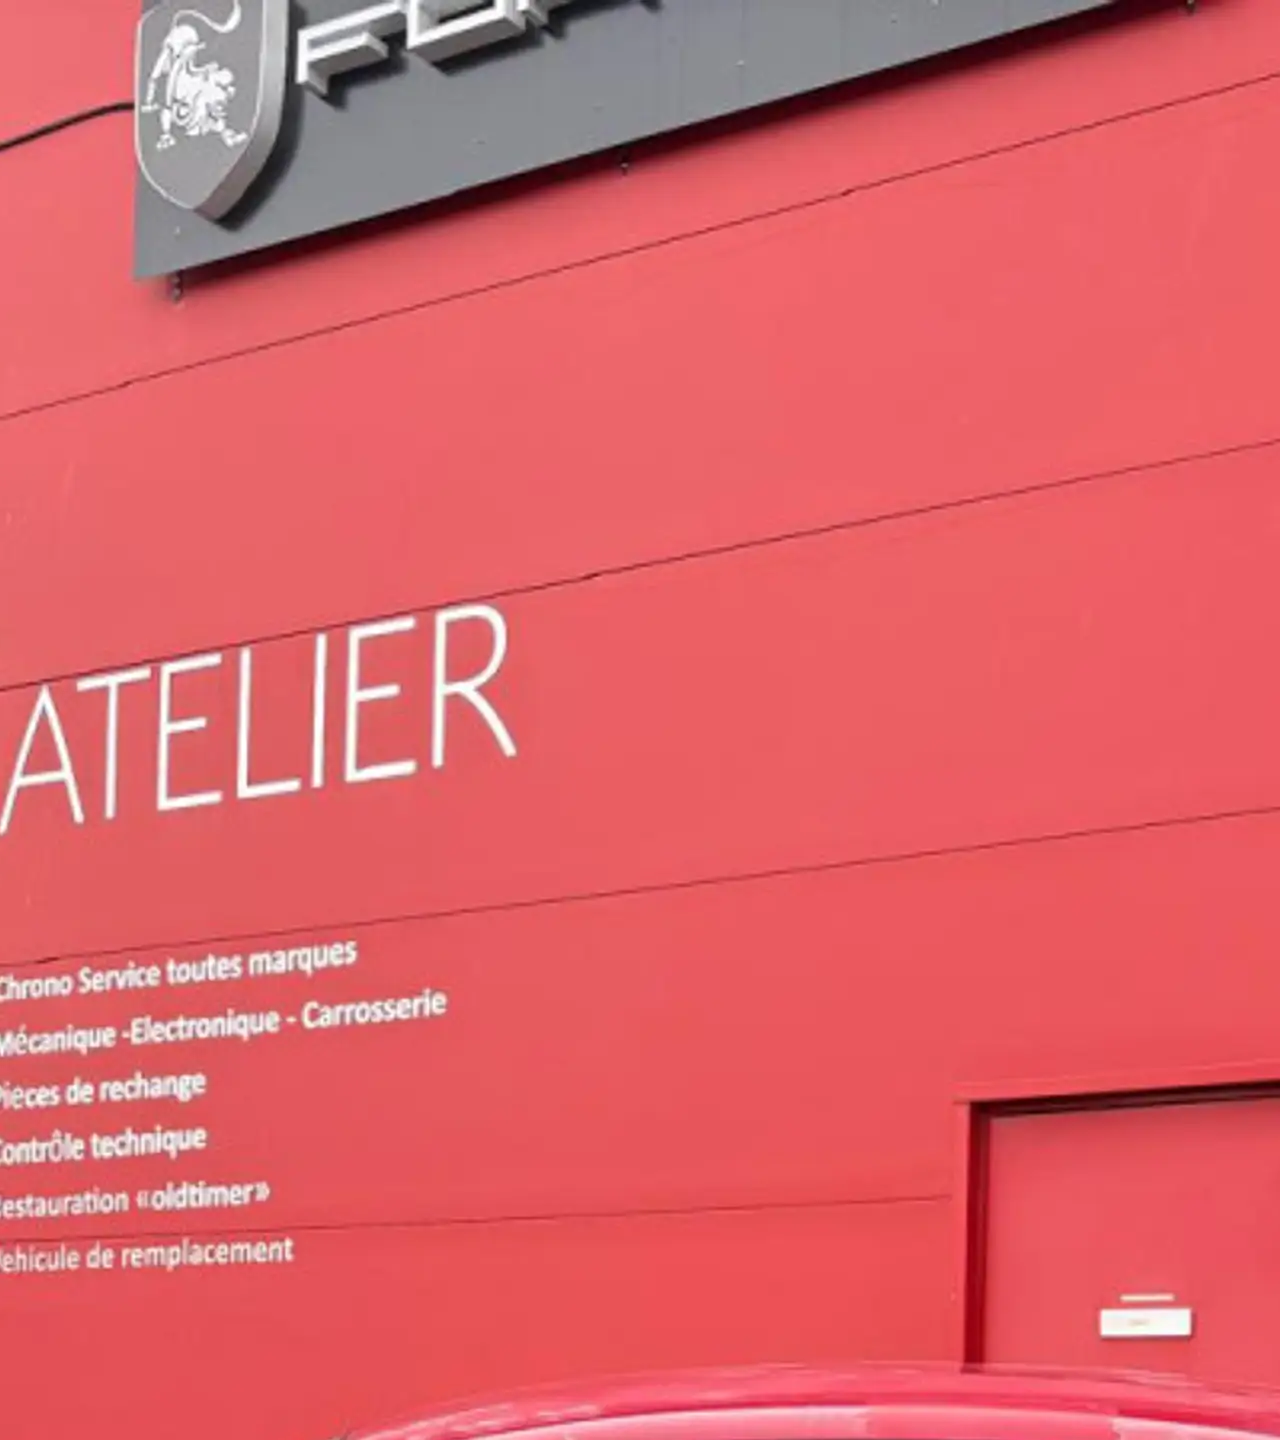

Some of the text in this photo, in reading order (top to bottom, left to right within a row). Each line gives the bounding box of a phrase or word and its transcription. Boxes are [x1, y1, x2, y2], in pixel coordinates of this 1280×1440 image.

[78, 963, 160, 994] Service
[166, 953, 242, 984] toutes
[249, 940, 357, 977] marques
[302, 987, 447, 1029] Carrosserie
[65, 1076, 93, 1104] de
[100, 1071, 206, 1101] rechange
[90, 1124, 207, 1160] technique
[136, 1180, 270, 1212] «oldtimer»
[86, 1241, 114, 1269] de
[121, 1238, 294, 1272] remplacement
